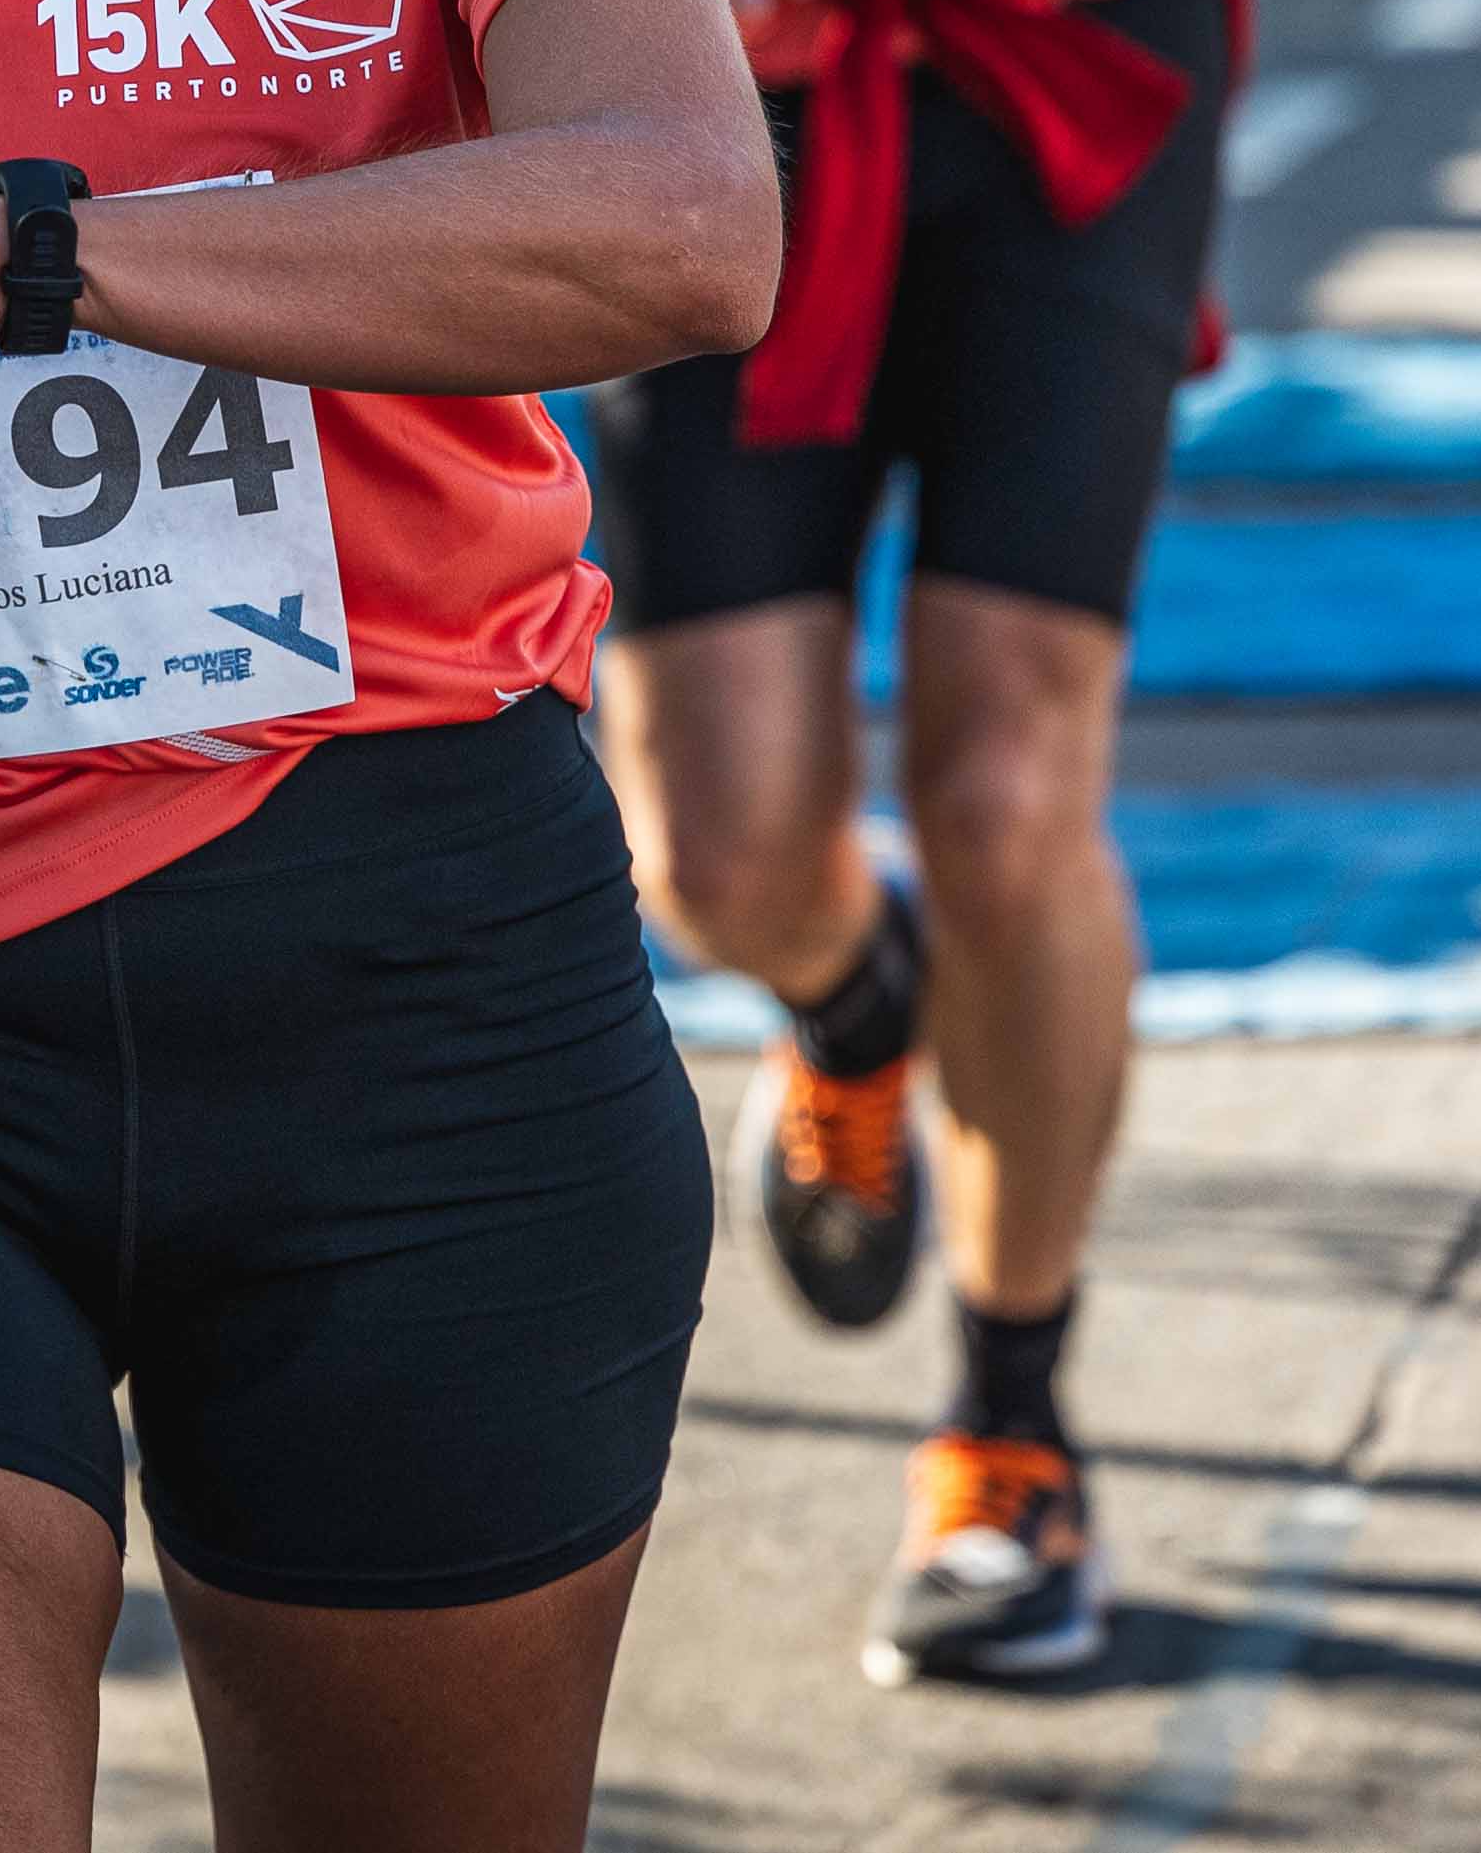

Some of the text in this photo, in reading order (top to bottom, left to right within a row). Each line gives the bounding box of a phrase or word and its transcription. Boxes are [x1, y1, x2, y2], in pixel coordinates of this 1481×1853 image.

[58, 50, 404, 108] PUERTO NORTE
[38, 562, 173, 606] Luciana
[164, 648, 252, 676] POWER
